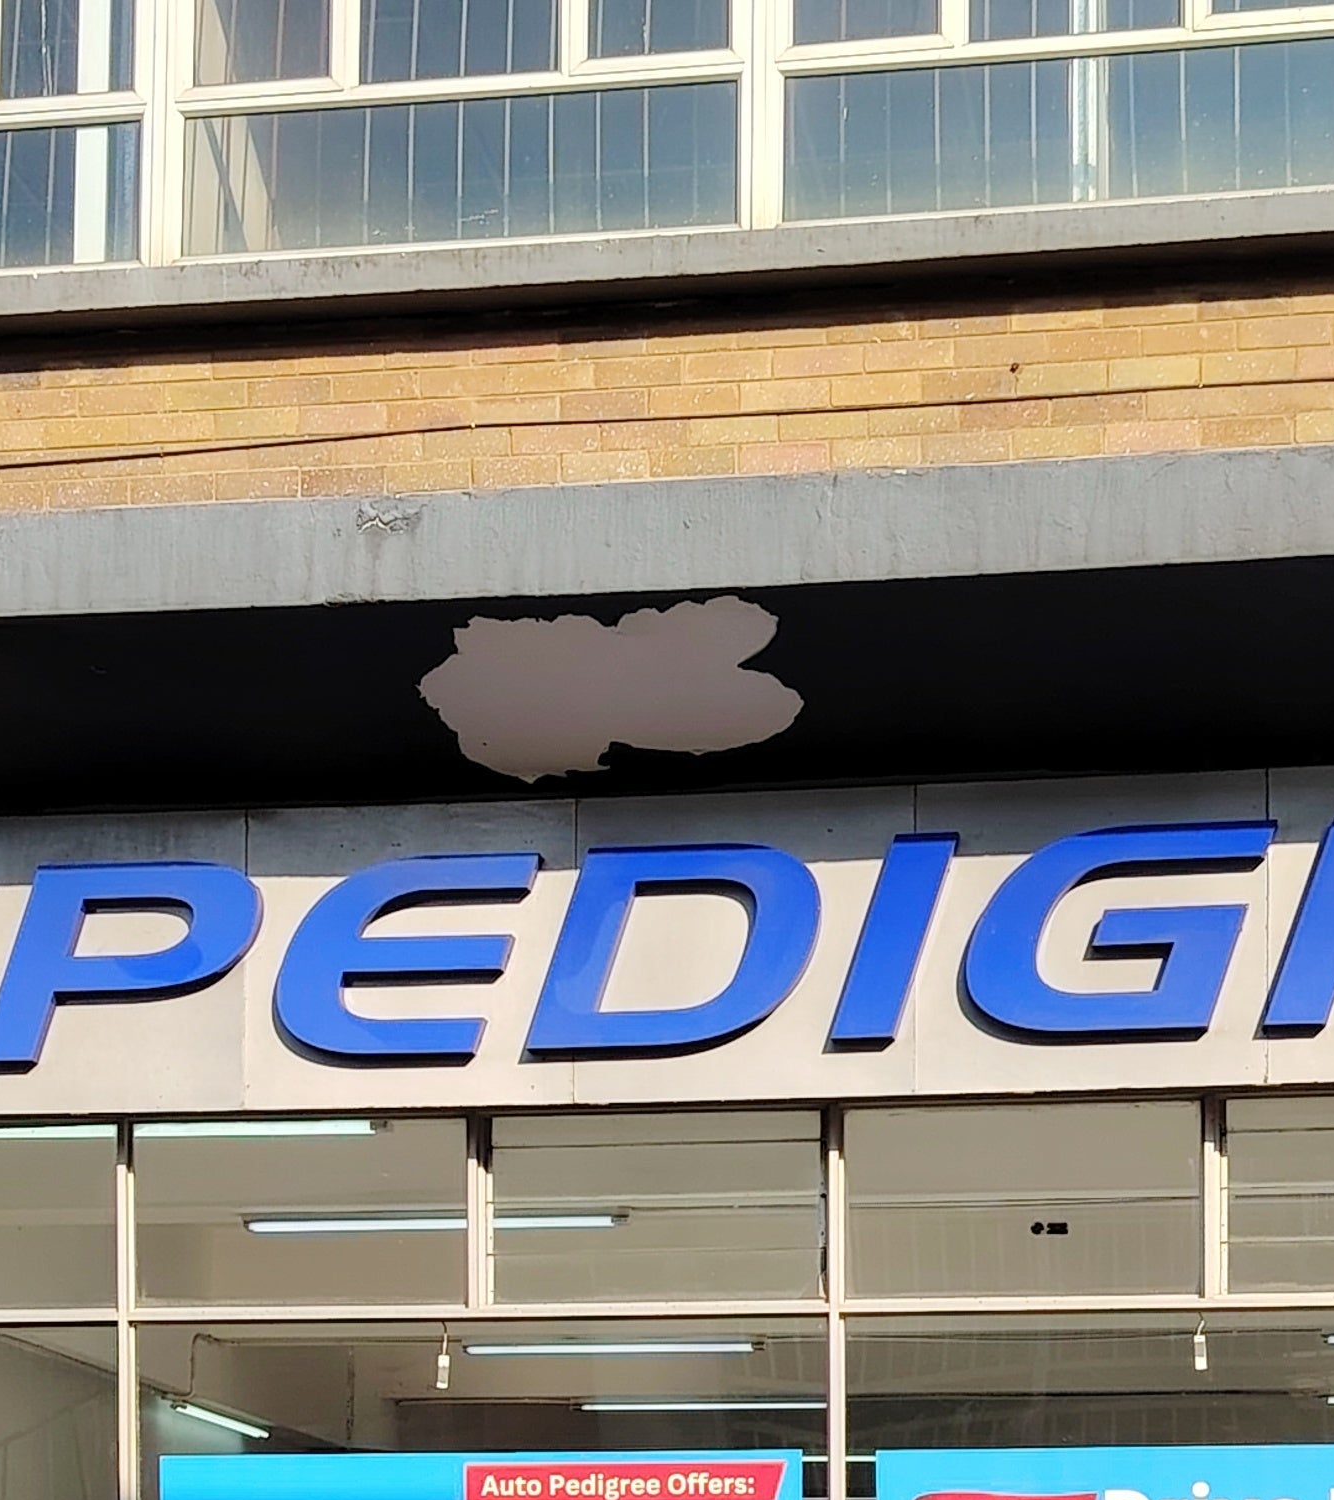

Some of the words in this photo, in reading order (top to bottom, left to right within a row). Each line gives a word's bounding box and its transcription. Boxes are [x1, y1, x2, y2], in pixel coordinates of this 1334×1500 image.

[481, 1474, 543, 1498] Auto
[549, 1473, 660, 1500] Pedigree
[667, 1472, 755, 1496] Offers:
